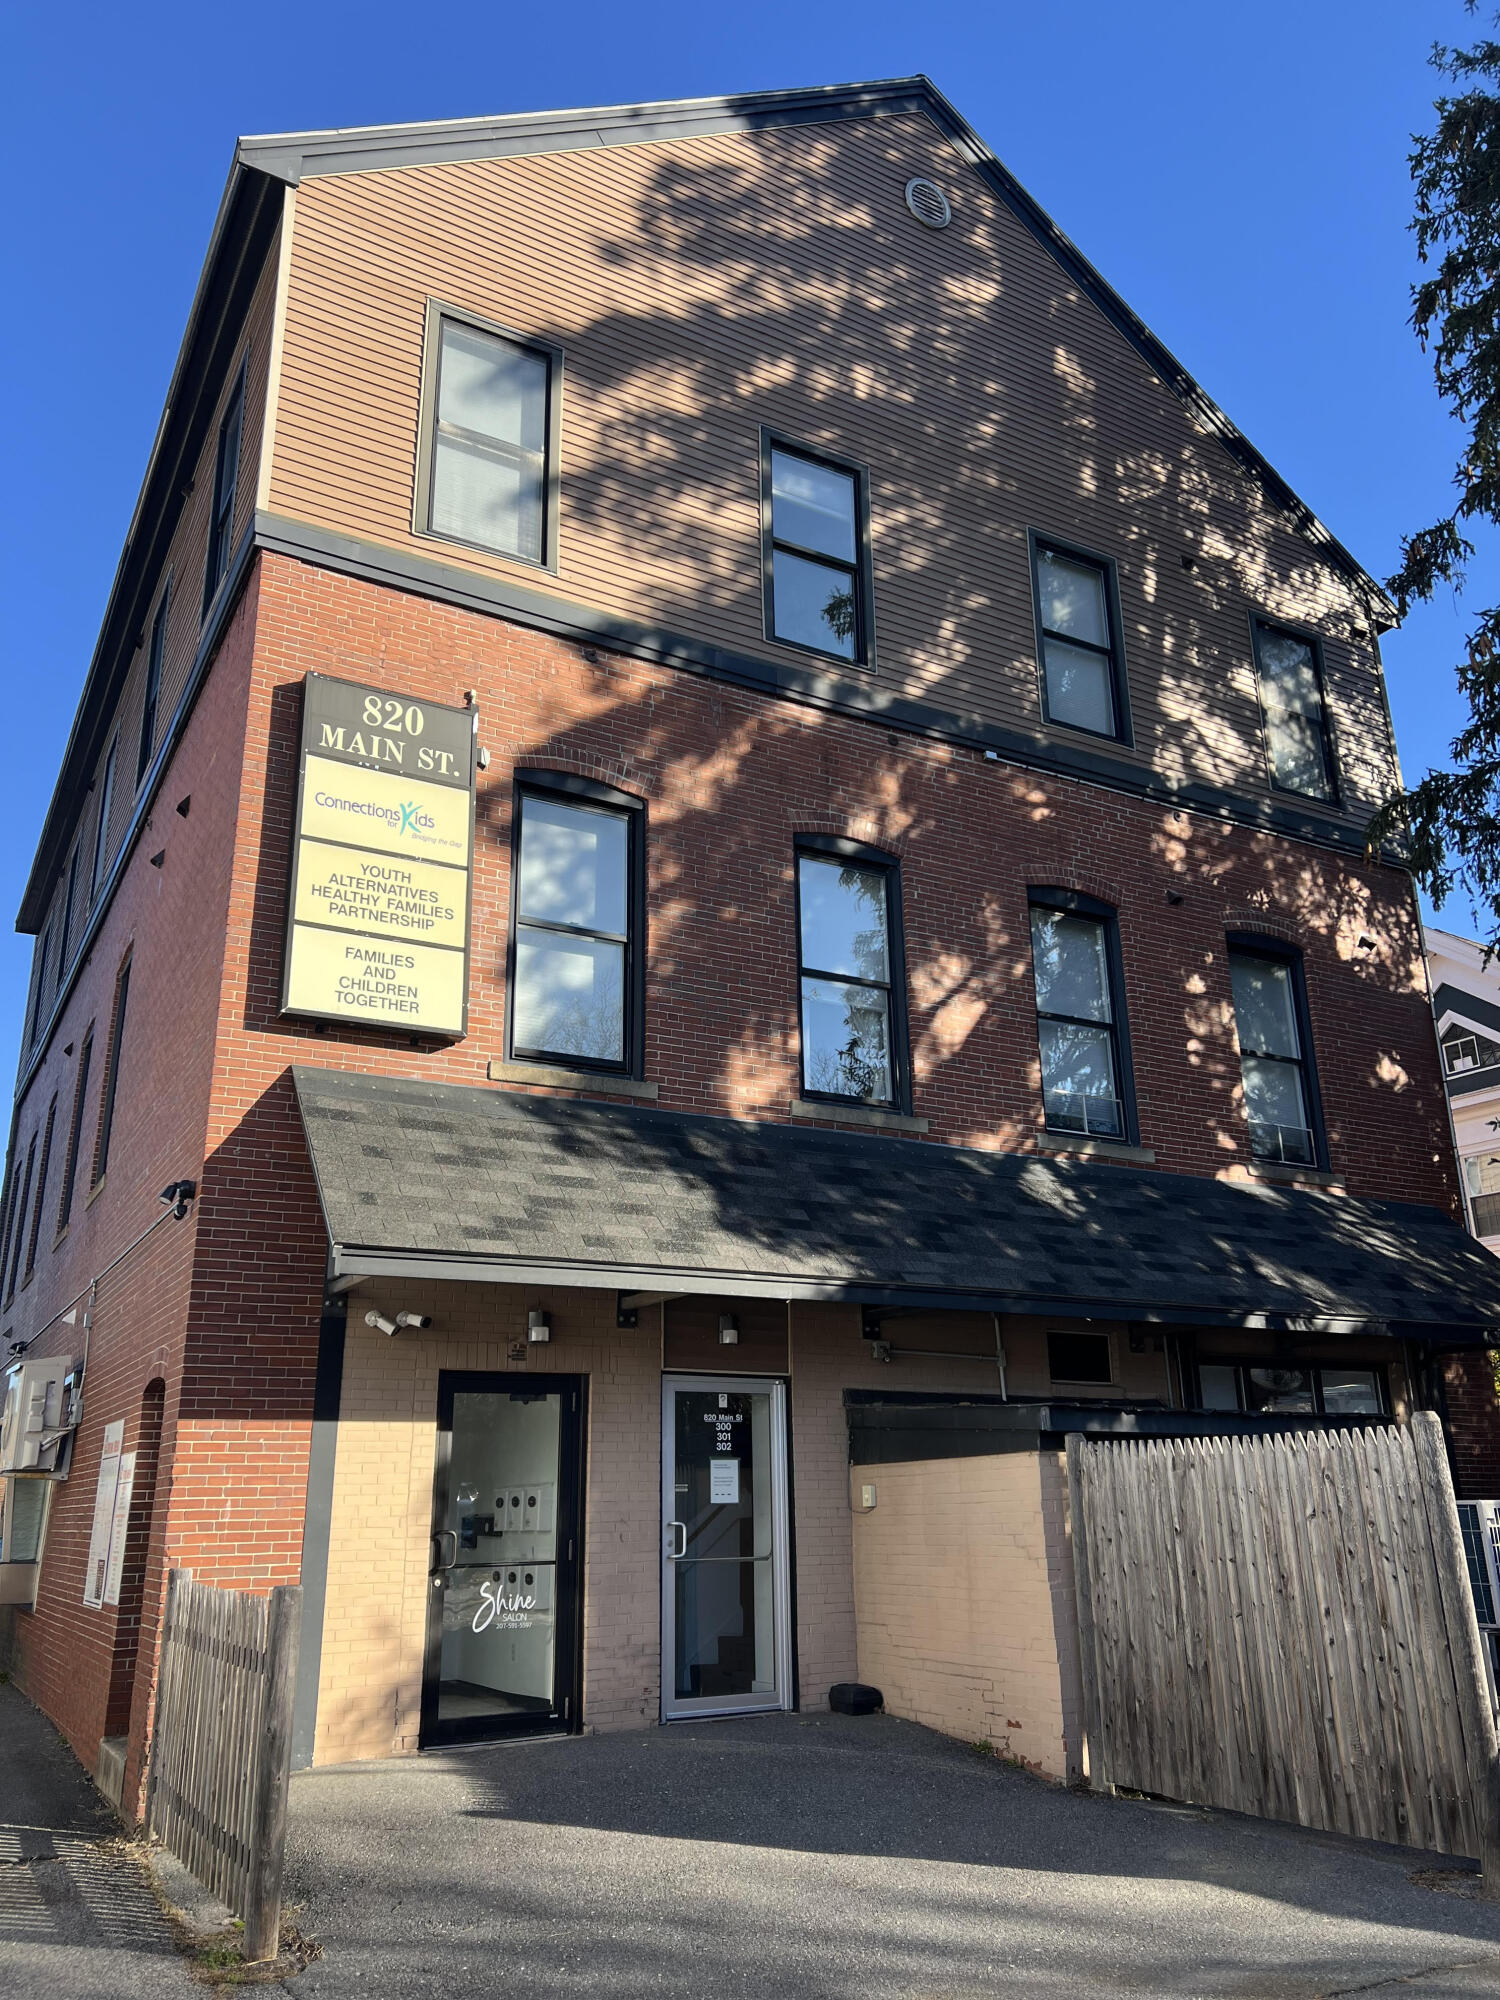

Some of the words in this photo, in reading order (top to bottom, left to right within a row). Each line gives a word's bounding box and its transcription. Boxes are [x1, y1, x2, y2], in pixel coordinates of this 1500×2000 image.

[362, 695, 424, 736] 820
[318, 723, 406, 764] MAIN
[417, 747, 460, 777] ST.
[315, 792, 400, 822] Connections
[387, 819, 398, 828] for
[360, 863, 412, 884] YOUTH
[328, 873, 439, 903] ALTERNATIVES
[311, 884, 380, 907] HEALTHY
[387, 898, 454, 920] FAMILIES
[329, 902, 435, 931] PARTNERSHIP
[345, 947, 415, 969] FAMILIES
[363, 965, 396, 980] AND
[339, 976, 418, 999] CHILDREN
[335, 990, 420, 1014] TOGETHER
[716, 1422, 732, 1430] 300
[717, 1432, 731, 1440] 301
[716, 1442, 732, 1450] 302
[472, 1582, 536, 1633] Shine
[502, 1612, 527, 1622] SALON
